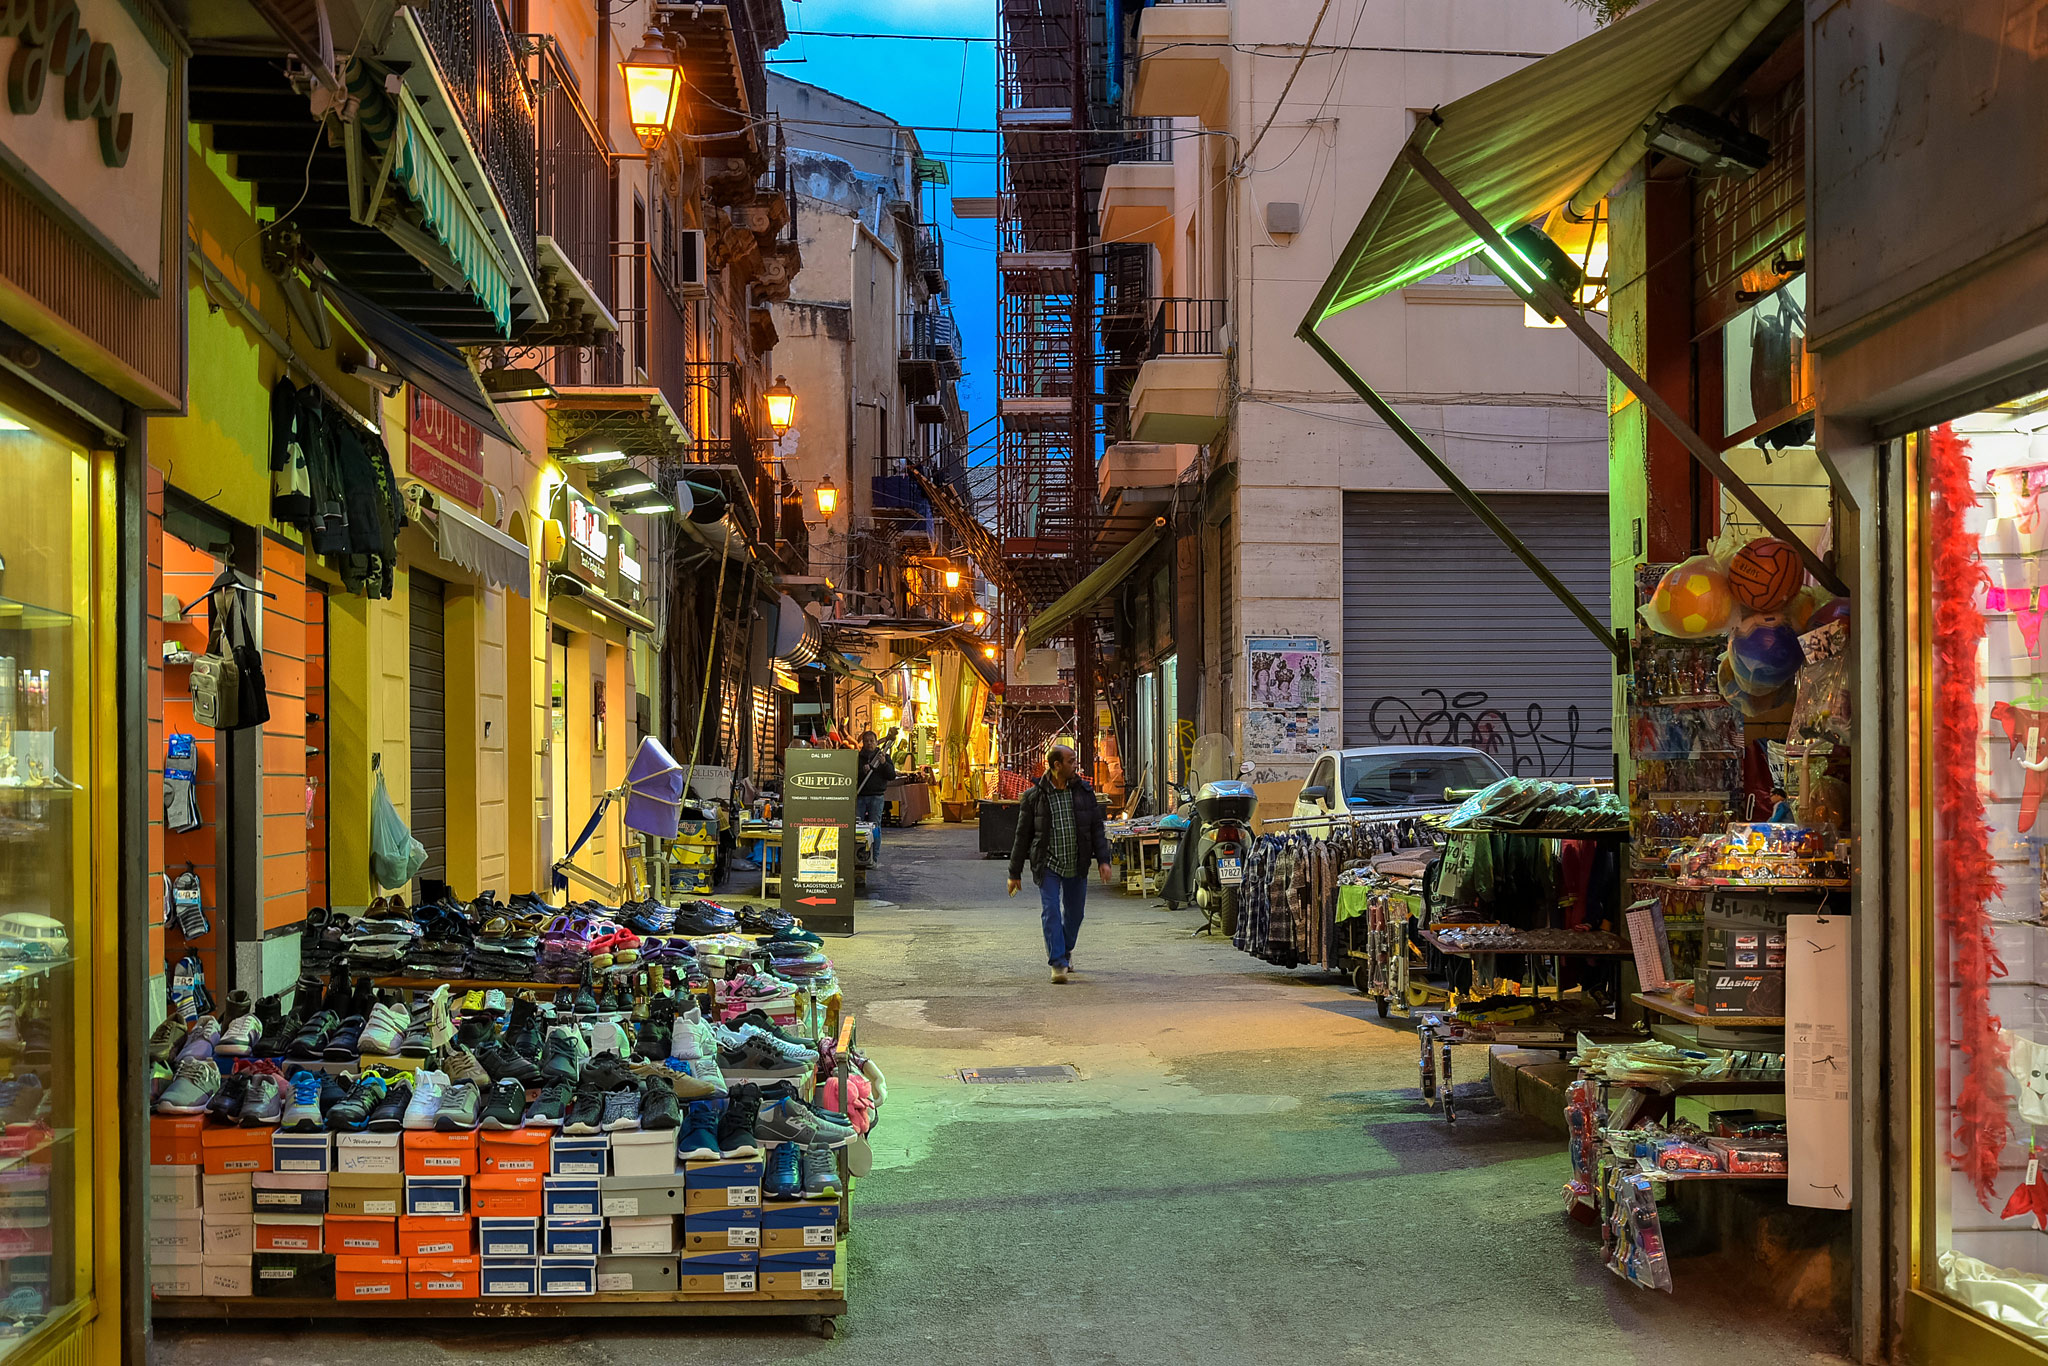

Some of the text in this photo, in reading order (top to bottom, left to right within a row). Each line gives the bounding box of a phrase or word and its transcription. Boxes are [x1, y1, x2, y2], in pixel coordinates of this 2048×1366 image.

[685, 768, 730, 778] COLLISTAR
[797, 776, 852, 786] F.lli PULEO
[1220, 868, 1241, 877] 17827
[1715, 976, 1761, 992] DASHER
[352, 1138, 382, 1146] Wellspring
[335, 1201, 356, 1209] NIADI
